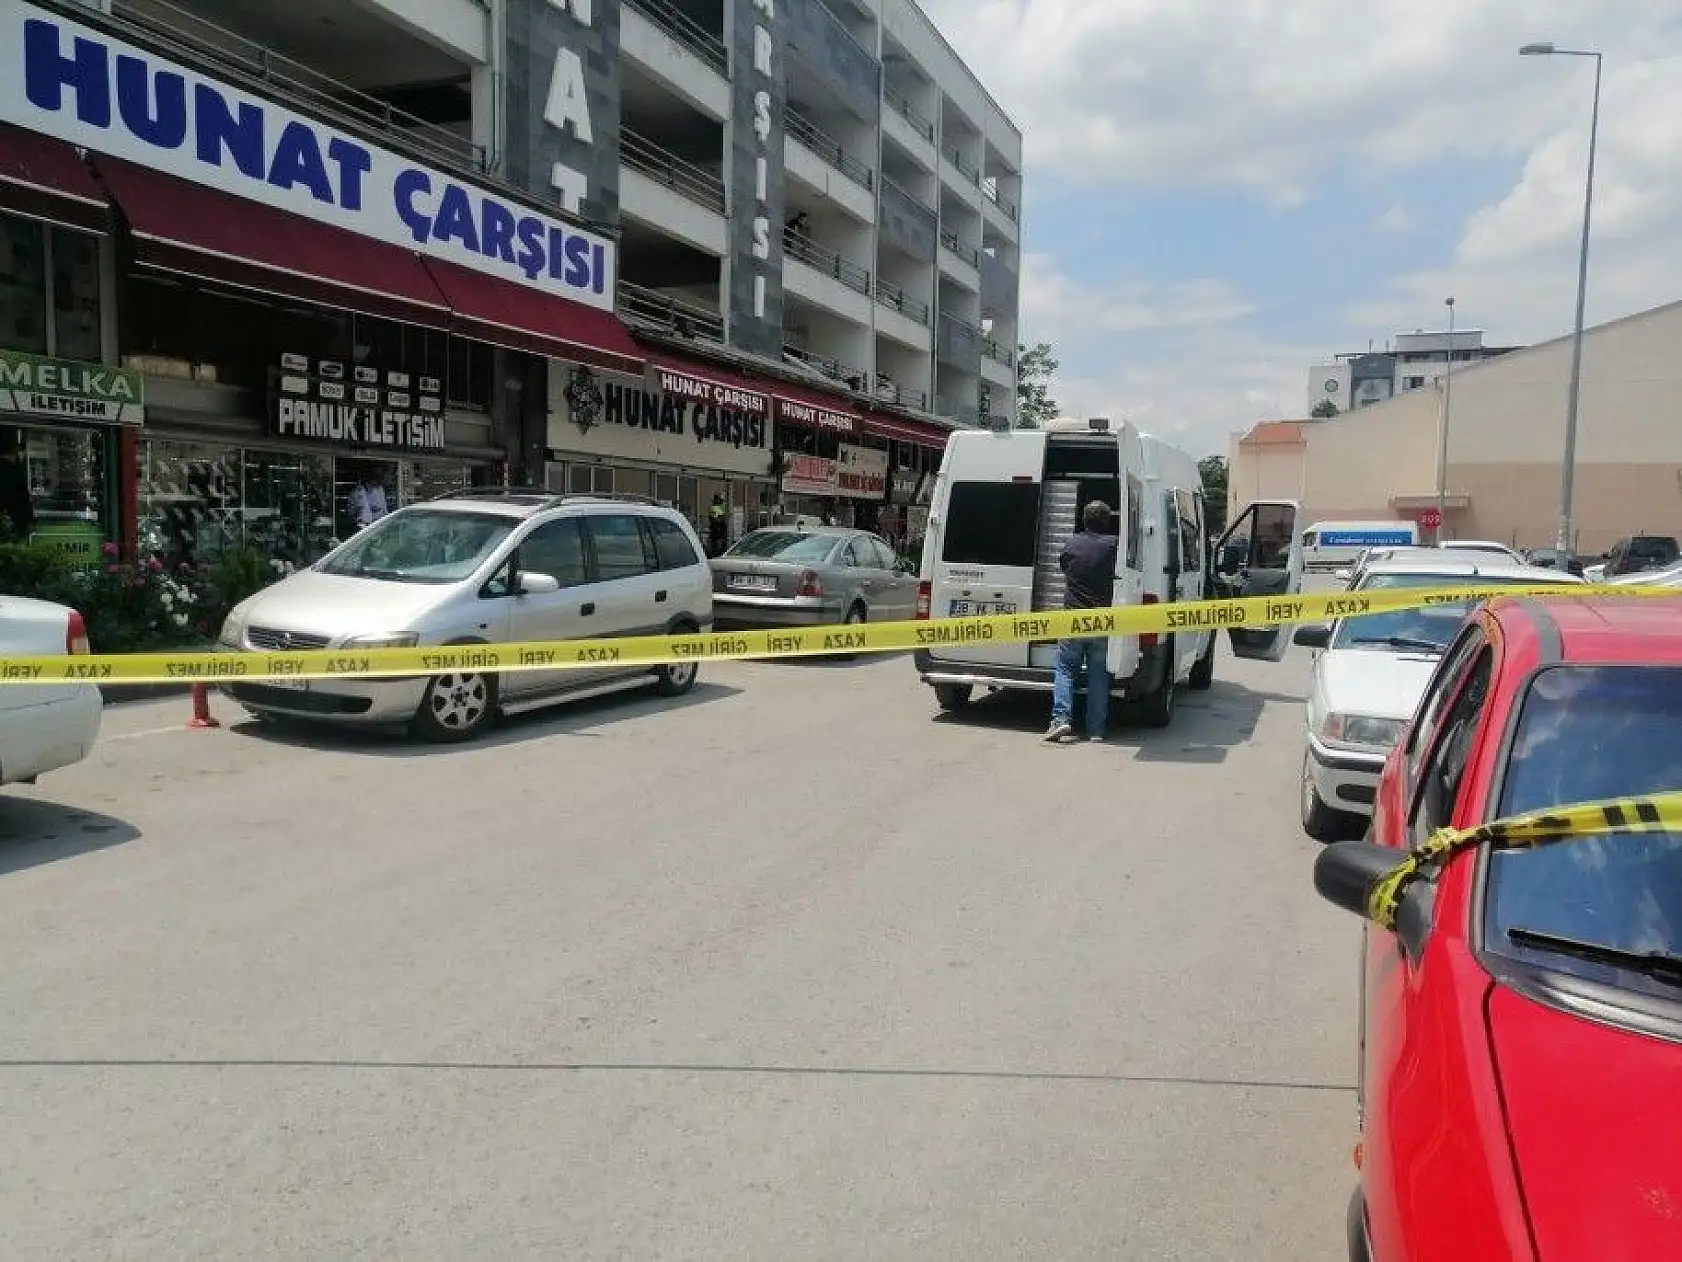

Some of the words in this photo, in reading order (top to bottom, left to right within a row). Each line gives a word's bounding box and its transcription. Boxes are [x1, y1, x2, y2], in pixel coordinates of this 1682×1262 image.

[24, 19, 371, 211] HUNAT
[393, 168, 606, 295] ÇARŞISI
[0, 359, 133, 398] MELKA
[662, 373, 710, 398] HUNAT
[279, 398, 358, 441] PAMUK
[605, 382, 687, 434] HUNAT
